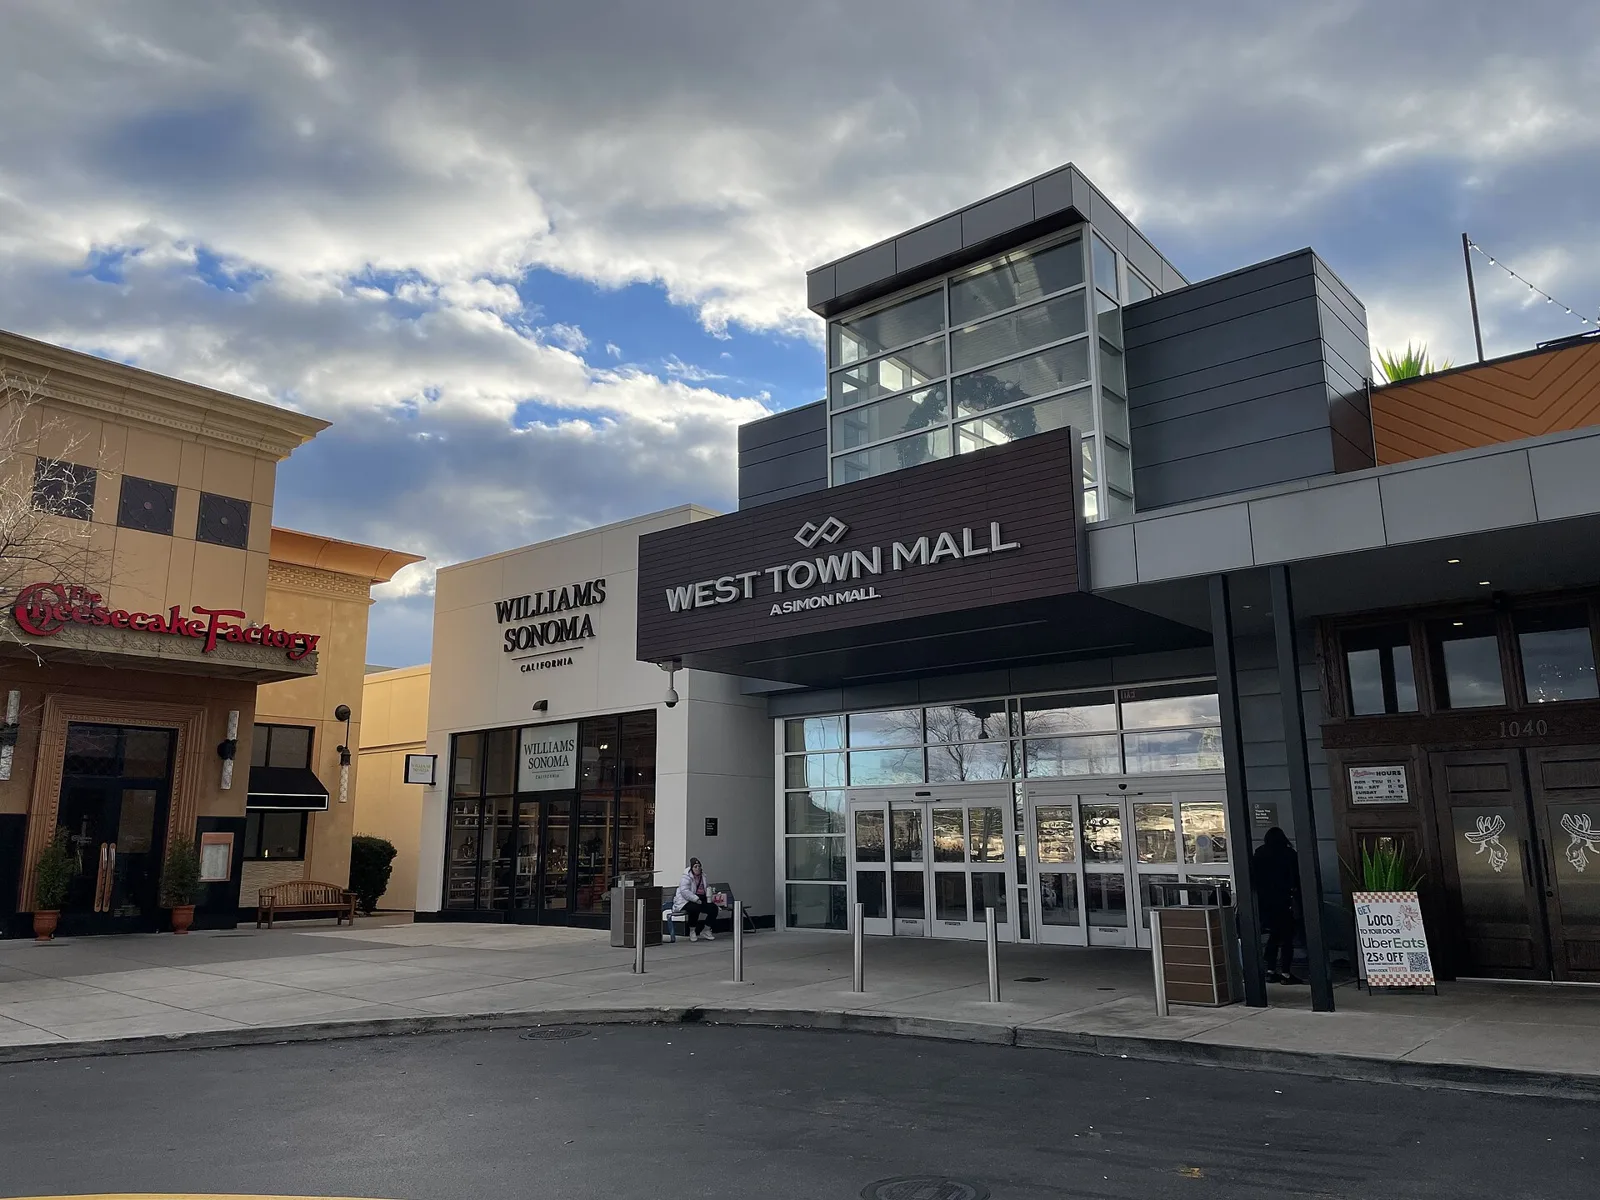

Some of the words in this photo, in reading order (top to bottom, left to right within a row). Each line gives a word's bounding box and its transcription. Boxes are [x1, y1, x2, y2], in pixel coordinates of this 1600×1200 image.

[666, 571, 761, 612] WEST
[765, 547, 882, 593] TOWN
[892, 522, 1021, 571] MALL
[65, 586, 102, 604] The
[494, 579, 606, 624] WILLIAMS
[769, 604, 783, 616] A
[783, 594, 834, 613] SIMON
[836, 587, 882, 605] MALL
[11, 582, 206, 637] Cheesecake
[192, 606, 321, 661] Factory
[504, 614, 596, 652] SONOMA
[520, 657, 573, 673] CALIFORNIA
[1500, 719, 1548, 738] 1040
[524, 739, 575, 755] WILLIAMS
[528, 755, 569, 770] SONOMA
[1357, 905, 1371, 915] GET
[1367, 915, 1393, 926] LOCO
[1387, 952, 1404, 962] OFF
